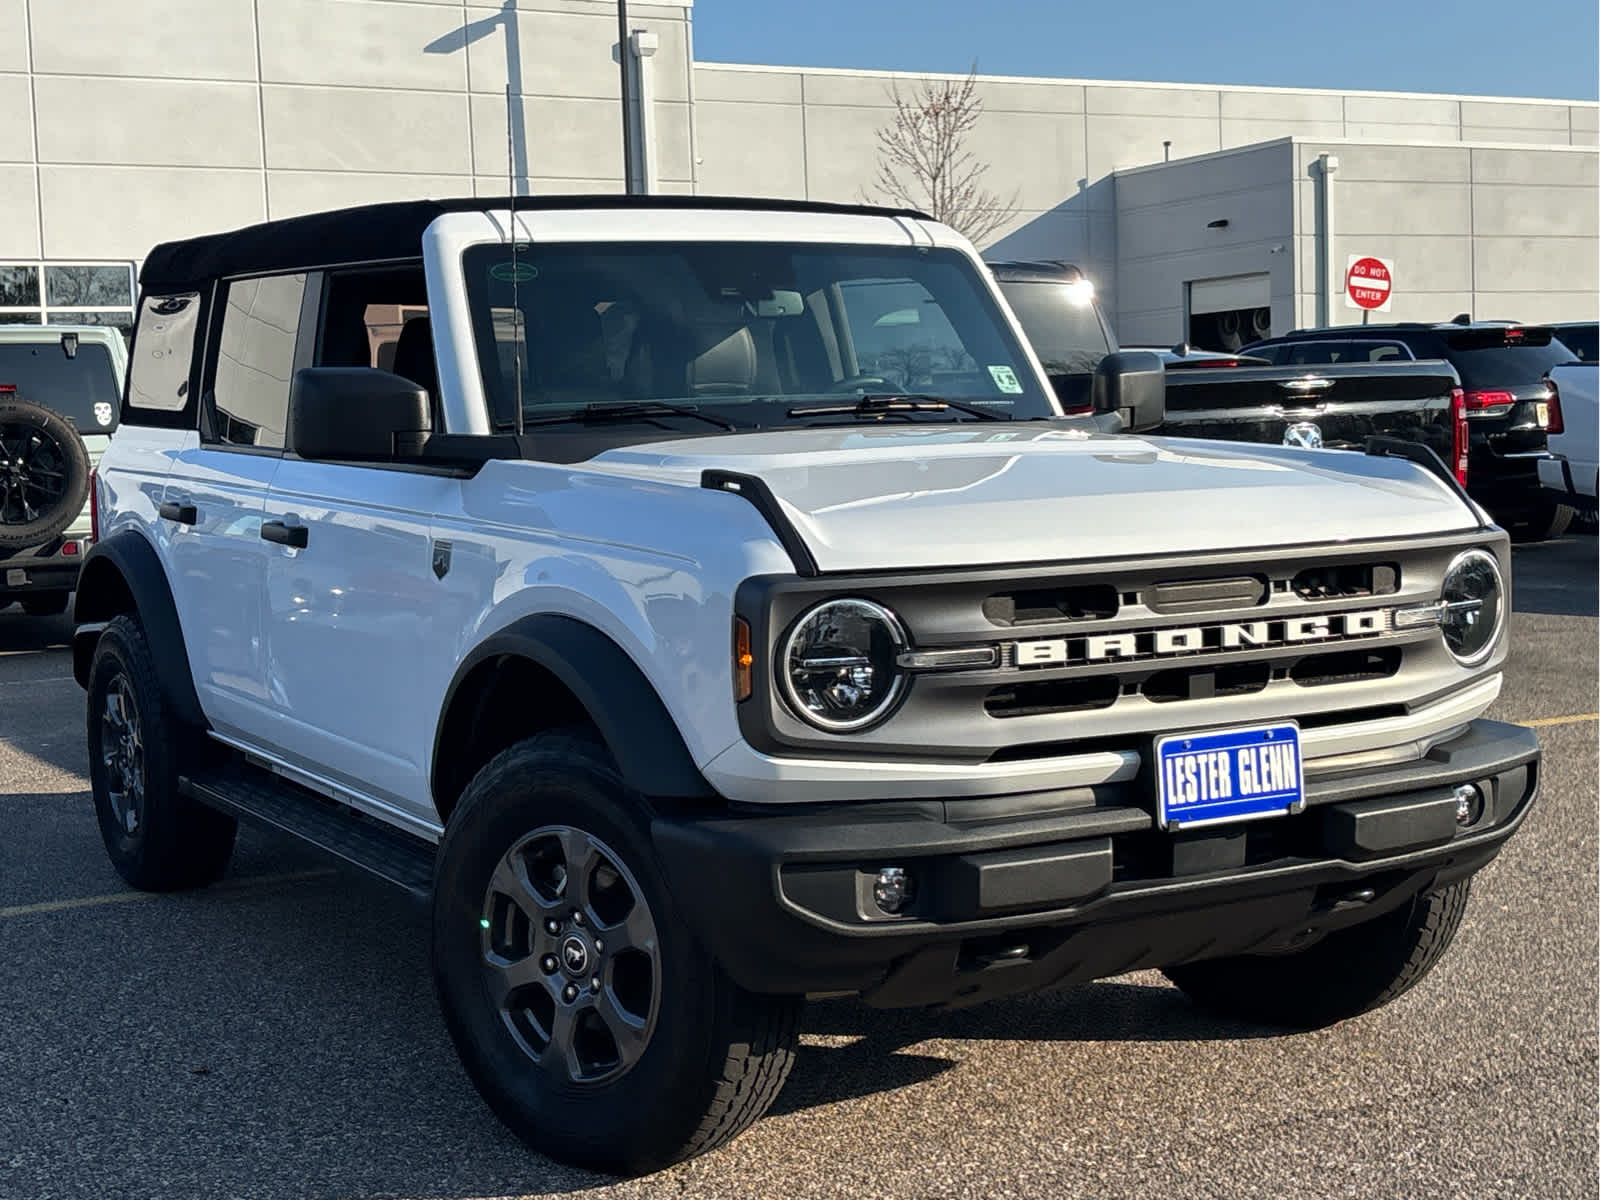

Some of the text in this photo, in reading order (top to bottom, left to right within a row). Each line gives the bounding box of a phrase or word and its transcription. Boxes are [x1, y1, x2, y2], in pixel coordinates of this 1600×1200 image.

[1354, 265, 1386, 278] DO NOT
[1355, 288, 1382, 301] ENTER
[1015, 610, 1387, 666] BRONCO
[1165, 743, 1297, 805] LESTER GLENN
